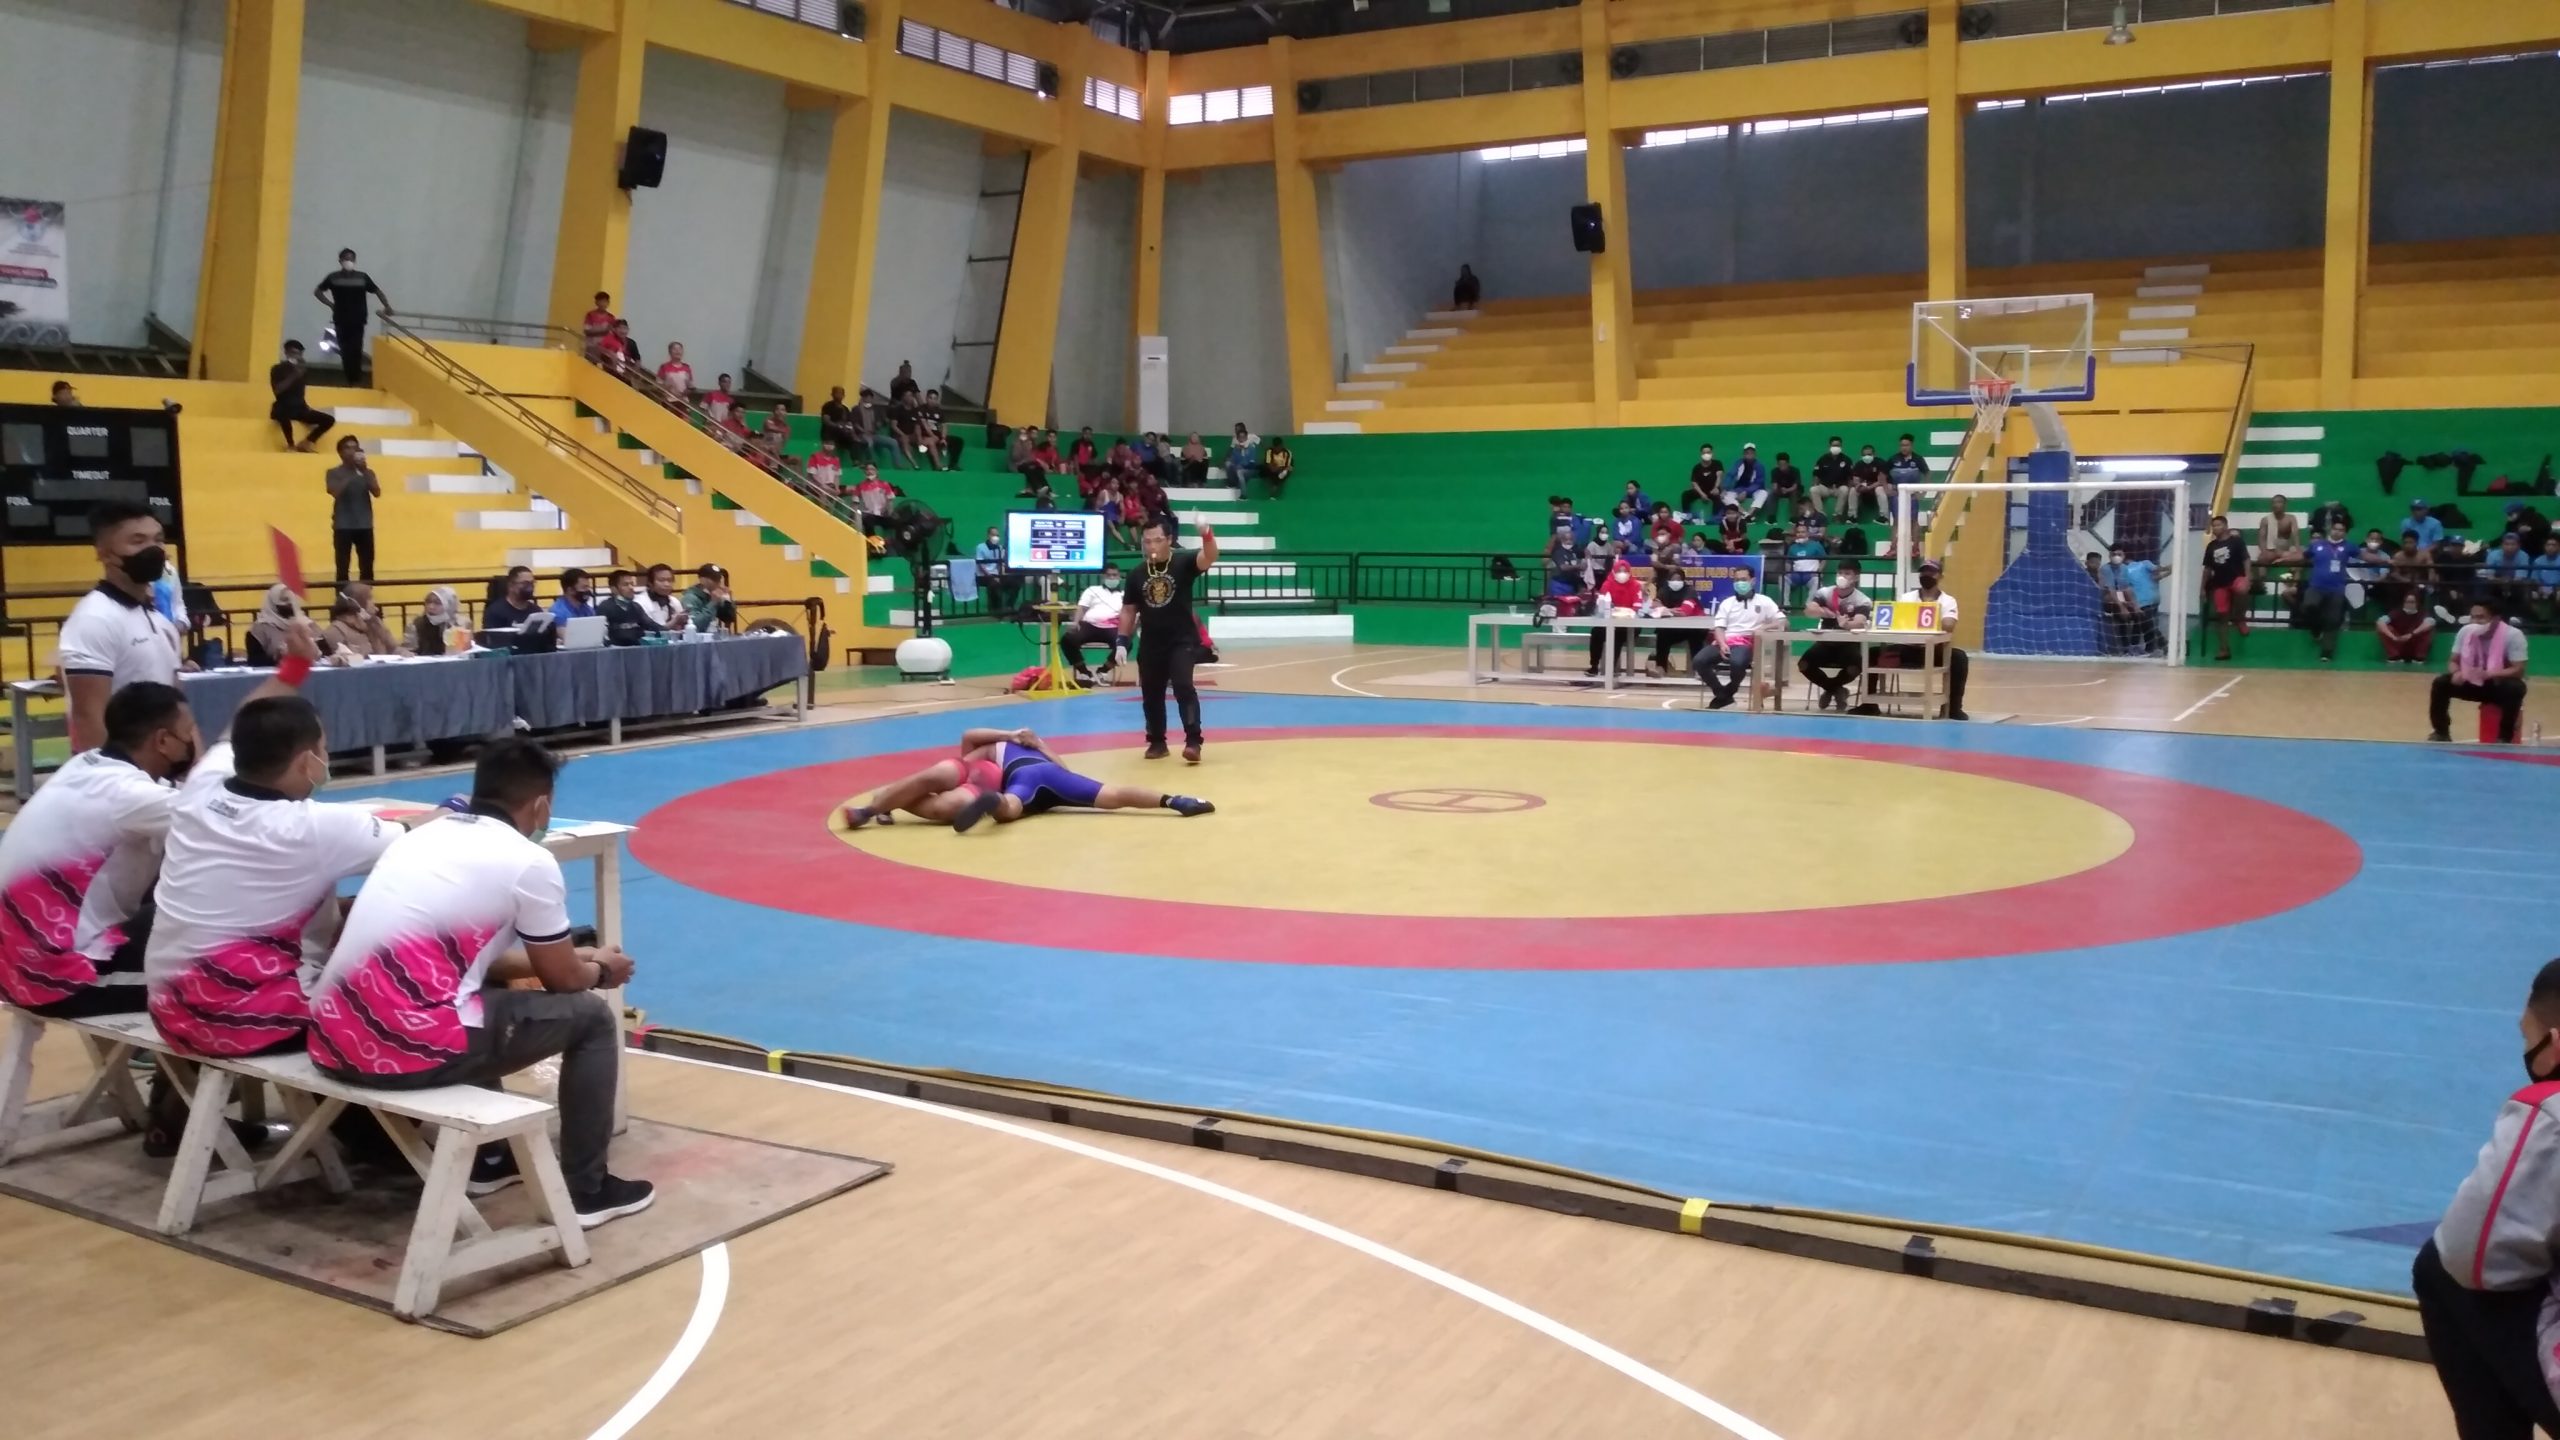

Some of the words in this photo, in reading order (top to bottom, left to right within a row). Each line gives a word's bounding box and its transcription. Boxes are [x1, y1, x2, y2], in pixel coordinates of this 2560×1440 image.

[66, 426, 109, 436] QUARTER
[72, 470, 110, 480] TIMEOUT
[6, 496, 32, 506] FOUL
[149, 496, 172, 506] FOUL
[1878, 608, 1891, 626] 2
[1921, 609, 1932, 627] 6
